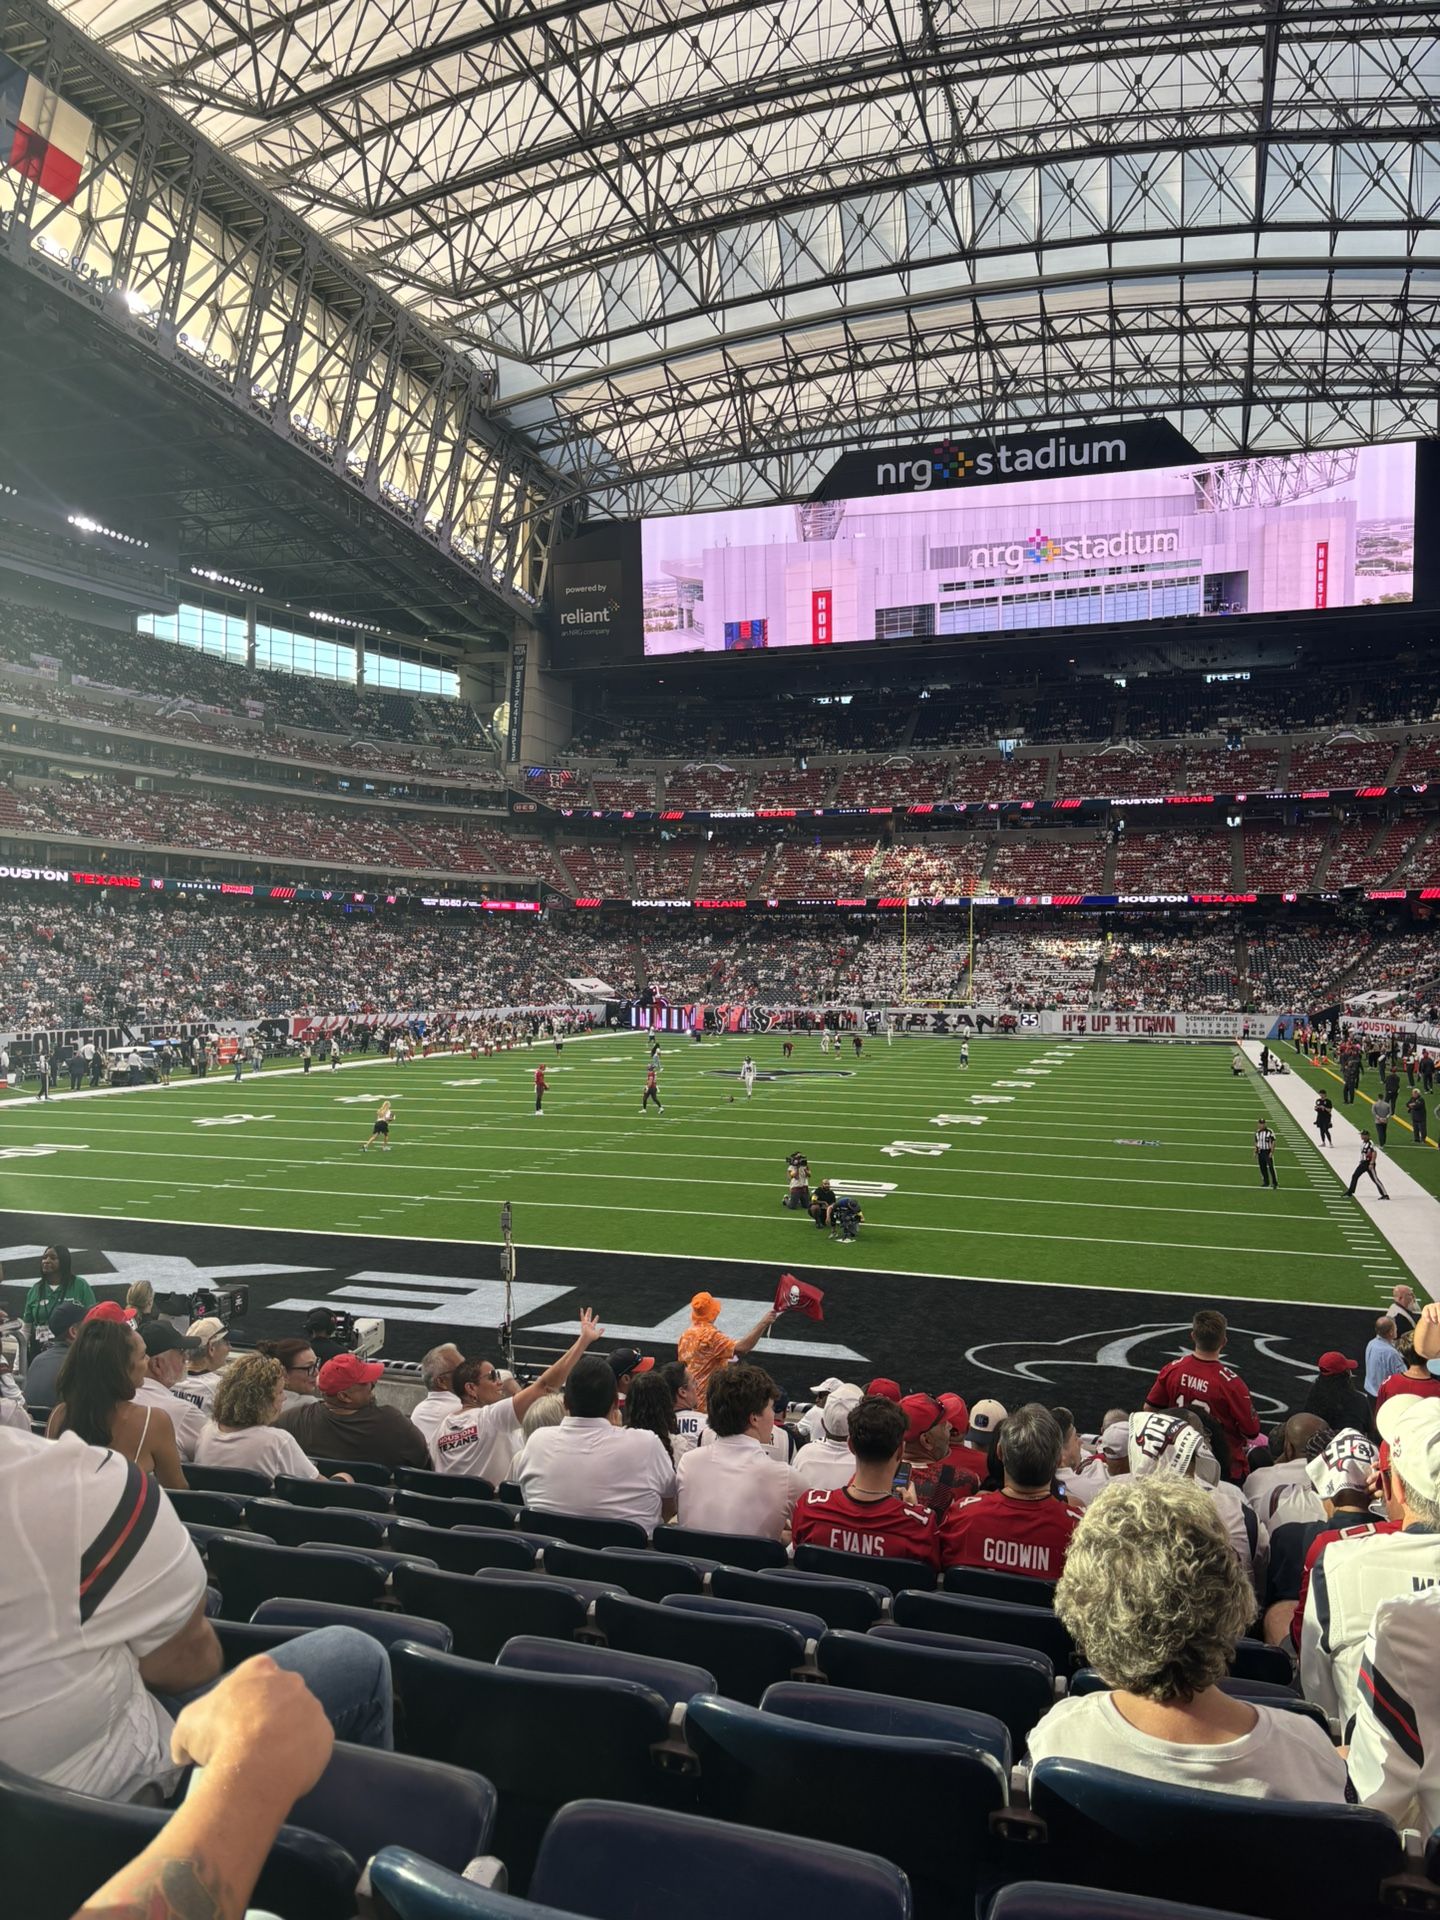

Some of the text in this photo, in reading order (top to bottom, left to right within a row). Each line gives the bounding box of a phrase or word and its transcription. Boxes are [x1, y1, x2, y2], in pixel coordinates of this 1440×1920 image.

[877, 438, 1126, 490] nrg stadium
[971, 530, 1179, 574] nrg stadium
[565, 584, 607, 595] powered by
[560, 607, 610, 625] reliant
[1110, 795, 1214, 806] HOUSTON TEXANS
[709, 810, 796, 819] HOUSTON TEXANS
[72, 872, 142, 888] TEXANS
[631, 899, 747, 908] HOUSTON TEXANS
[1118, 894, 1257, 904] HOUSTON TEXANS
[1022, 1014, 1038, 1026] 25
[1091, 1015, 1111, 1032] UP
[1357, 1021, 1397, 1034] HOUSTON
[1181, 1373, 1209, 1393] EVANS
[439, 1427, 475, 1443] HOUSTON
[439, 1435, 479, 1452] TEXANS
[1170, 1431, 1192, 1468] LIBERTY
[807, 1488, 831, 1504] 3
[830, 1528, 885, 1557] EVANS
[983, 1537, 1050, 1572] GODWIN
